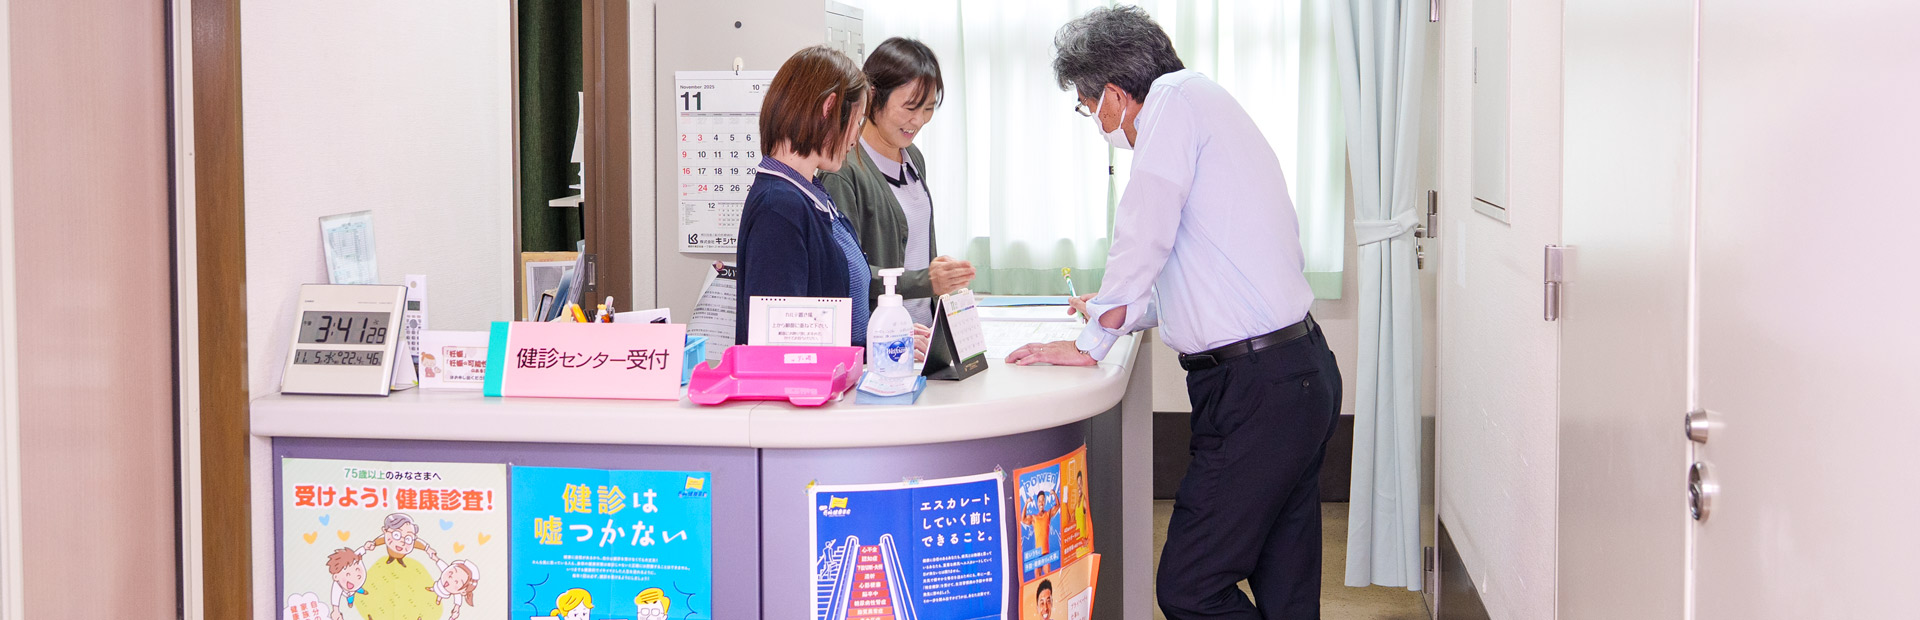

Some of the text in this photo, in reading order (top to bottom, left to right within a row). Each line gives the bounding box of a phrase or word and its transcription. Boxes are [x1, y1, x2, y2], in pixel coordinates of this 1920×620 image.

[680, 91, 702, 111] 11
[682, 134, 752, 142] 2 3 4 5 6
[682, 167, 756, 175] 16 17 18 19 20
[697, 184, 708, 192] 24
[713, 184, 724, 192] 25
[730, 184, 740, 192] 26
[715, 237, 737, 245] キシヤ
[720, 268, 737, 278] つい
[315, 315, 368, 343] 3:41
[366, 327, 388, 344] 29
[516, 347, 670, 371] 健診センター受付
[344, 468, 442, 481] 75歳以上のみなさまへ
[1025, 472, 1057, 493] POWER
[294, 485, 493, 511] 受けよう! 健康診査!
[562, 483, 658, 515] 健診は
[919, 493, 991, 512] エスカレート
[922, 511, 992, 530] していく前に
[534, 515, 688, 548] 嘘つかない
[921, 530, 993, 548] できること。
